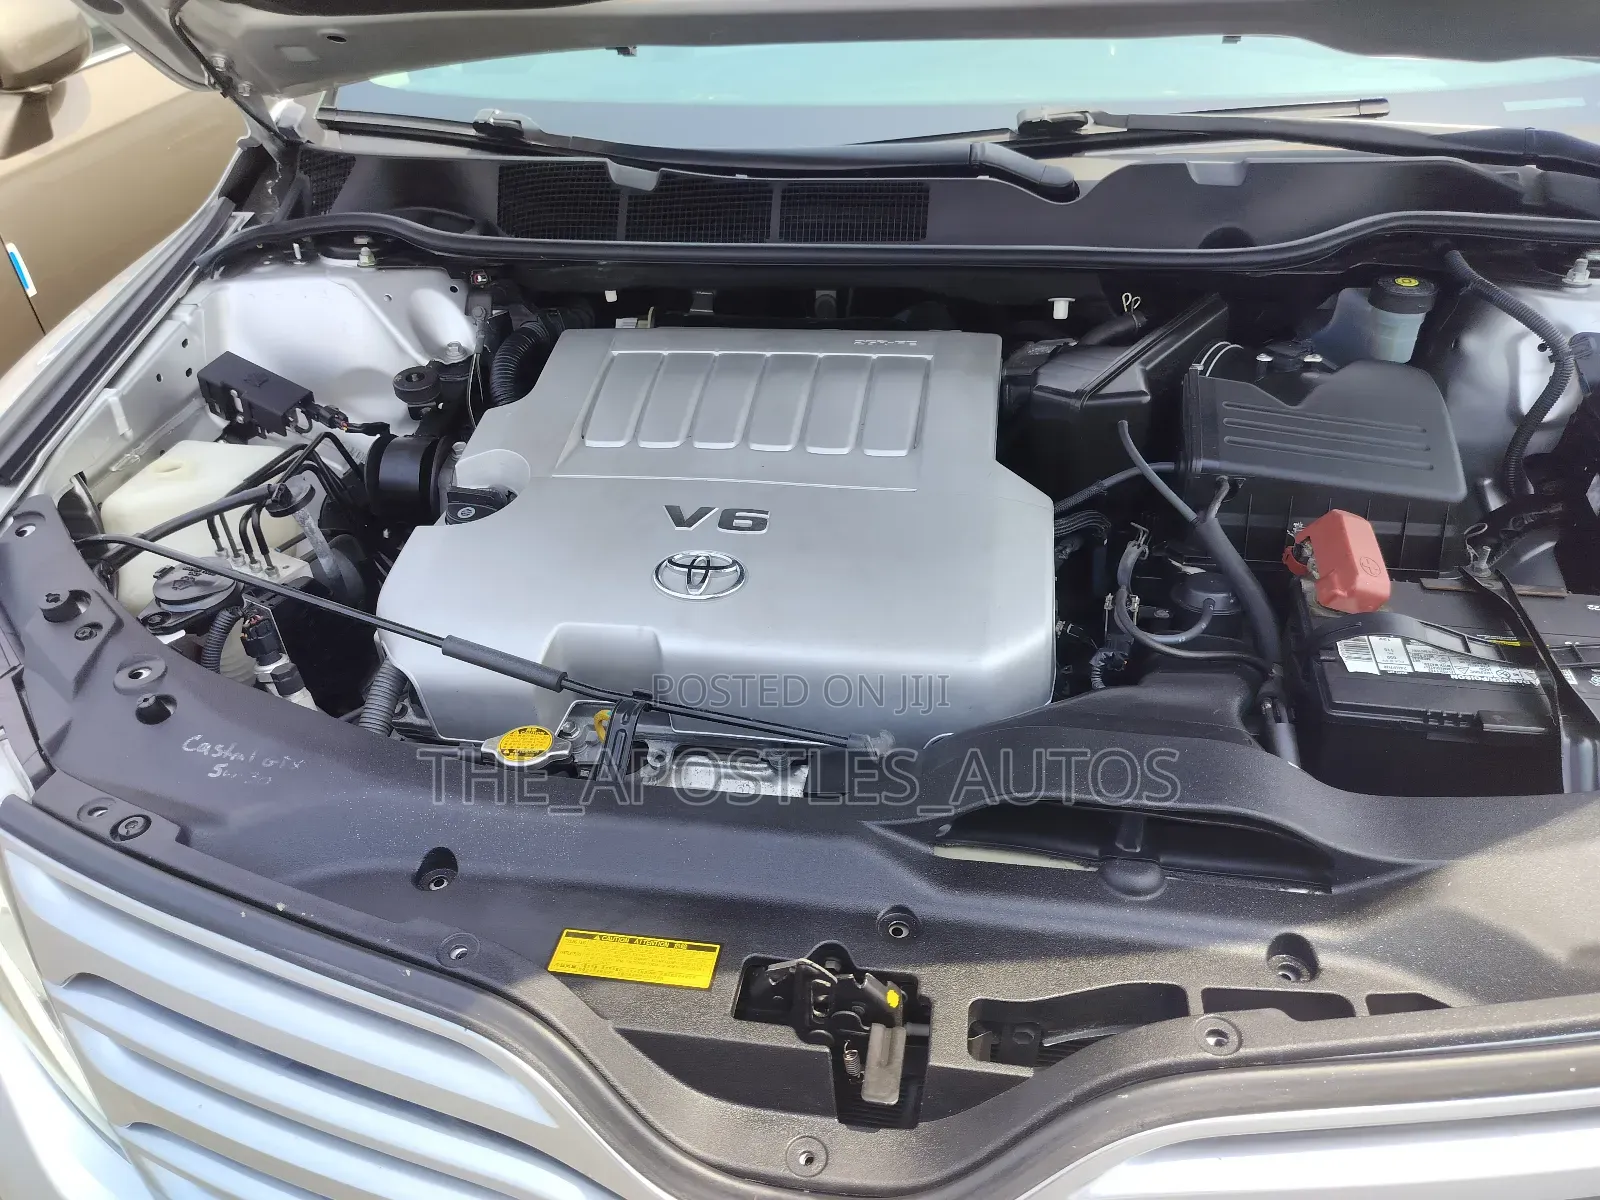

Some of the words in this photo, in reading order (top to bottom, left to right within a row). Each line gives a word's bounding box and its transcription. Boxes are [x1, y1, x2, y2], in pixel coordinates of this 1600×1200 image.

[663, 504, 770, 534] V6
[601, 935, 630, 944] CAUTION
[634, 938, 670, 948] ATTENTION
